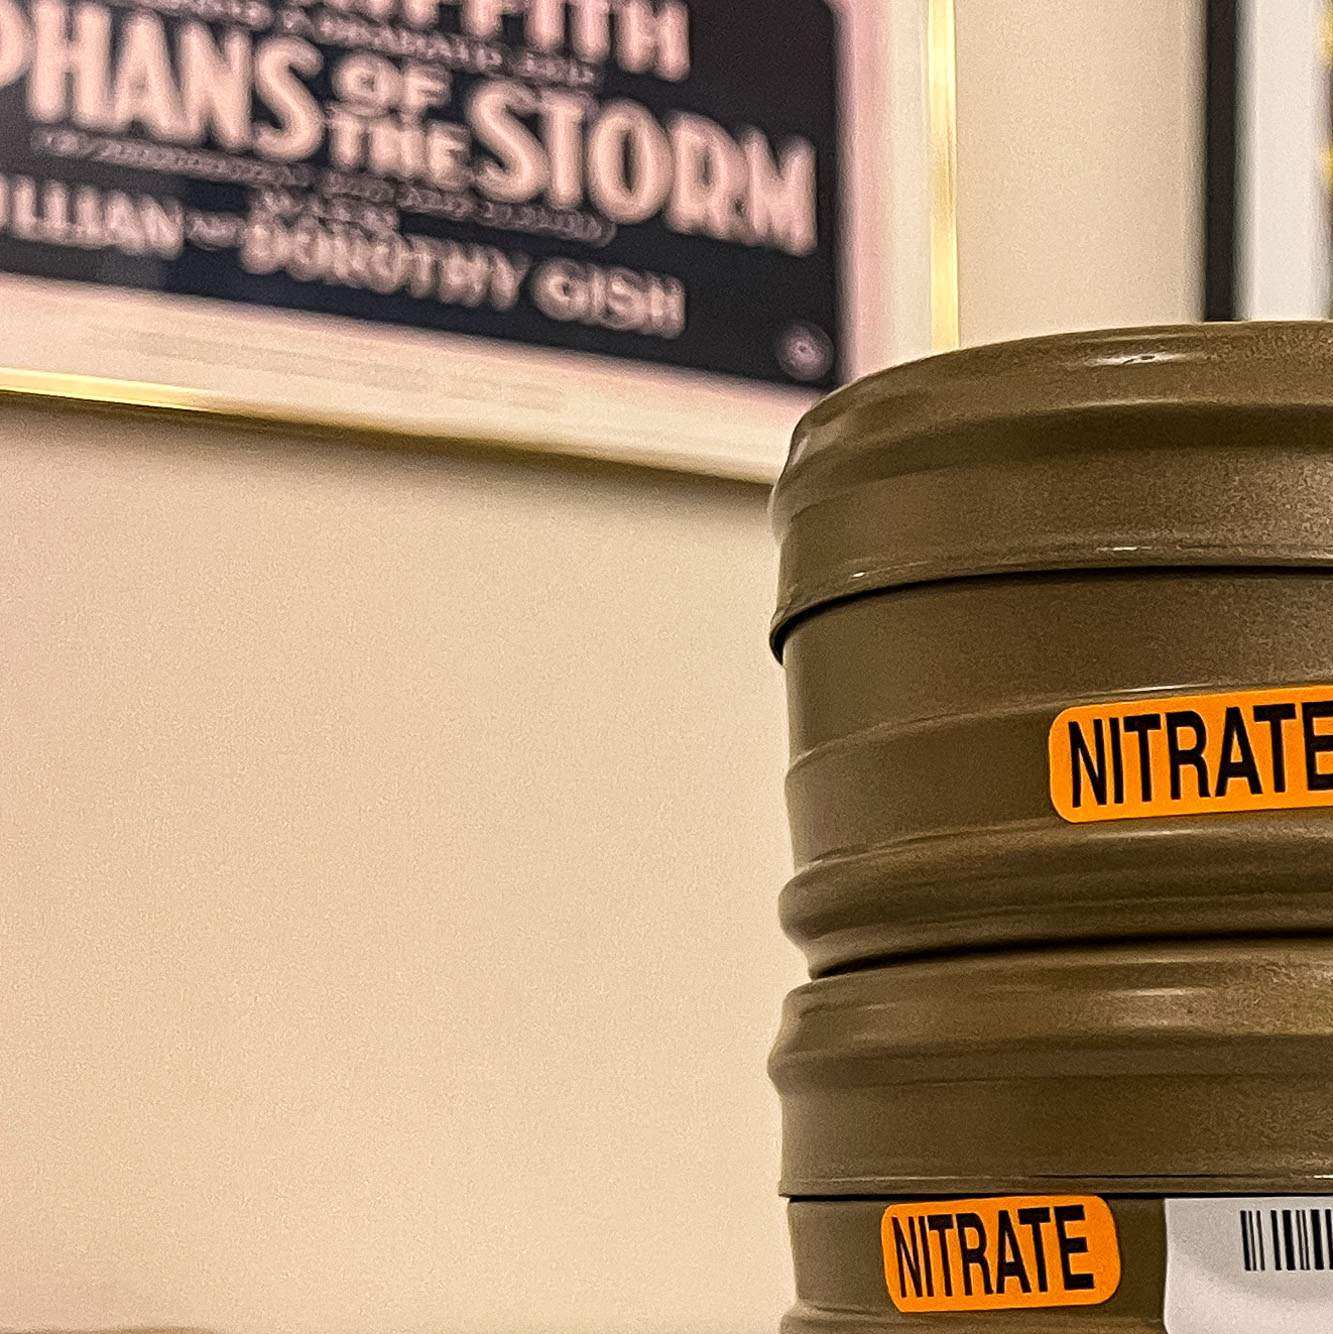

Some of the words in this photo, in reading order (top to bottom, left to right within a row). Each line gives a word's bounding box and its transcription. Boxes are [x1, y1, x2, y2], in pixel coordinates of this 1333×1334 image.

[332, 50, 452, 110] OF
[328, 104, 470, 190] THE
[466, 80, 818, 256] STORM
[241, 218, 527, 310] DOROTHY
[533, 257, 686, 339] GISH
[892, 1204, 1095, 1298] NITRATE
